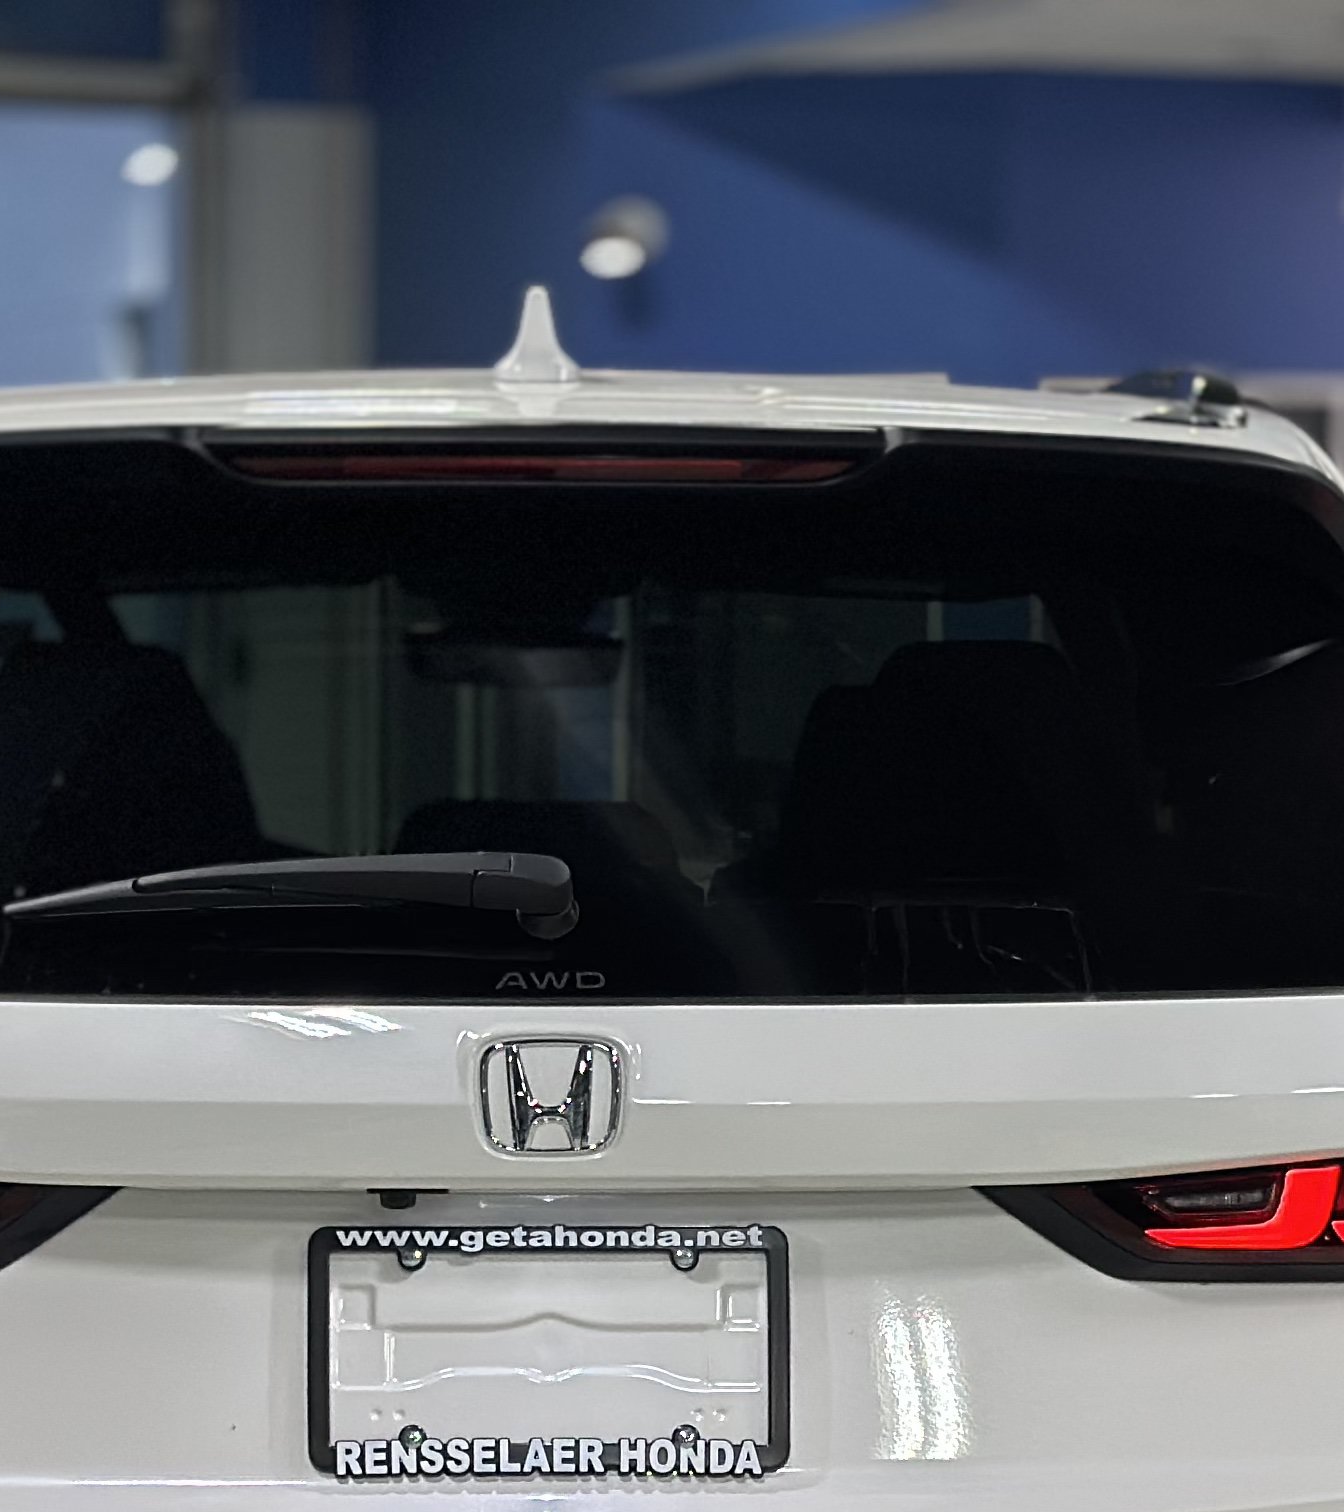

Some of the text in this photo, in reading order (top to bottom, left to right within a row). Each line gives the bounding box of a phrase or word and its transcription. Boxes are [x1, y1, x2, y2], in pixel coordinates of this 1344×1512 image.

[495, 971, 606, 990] AWD
[336, 1225, 764, 1252] www.getahonda.net
[336, 1438, 763, 1475] RENSSELAER HONDA
